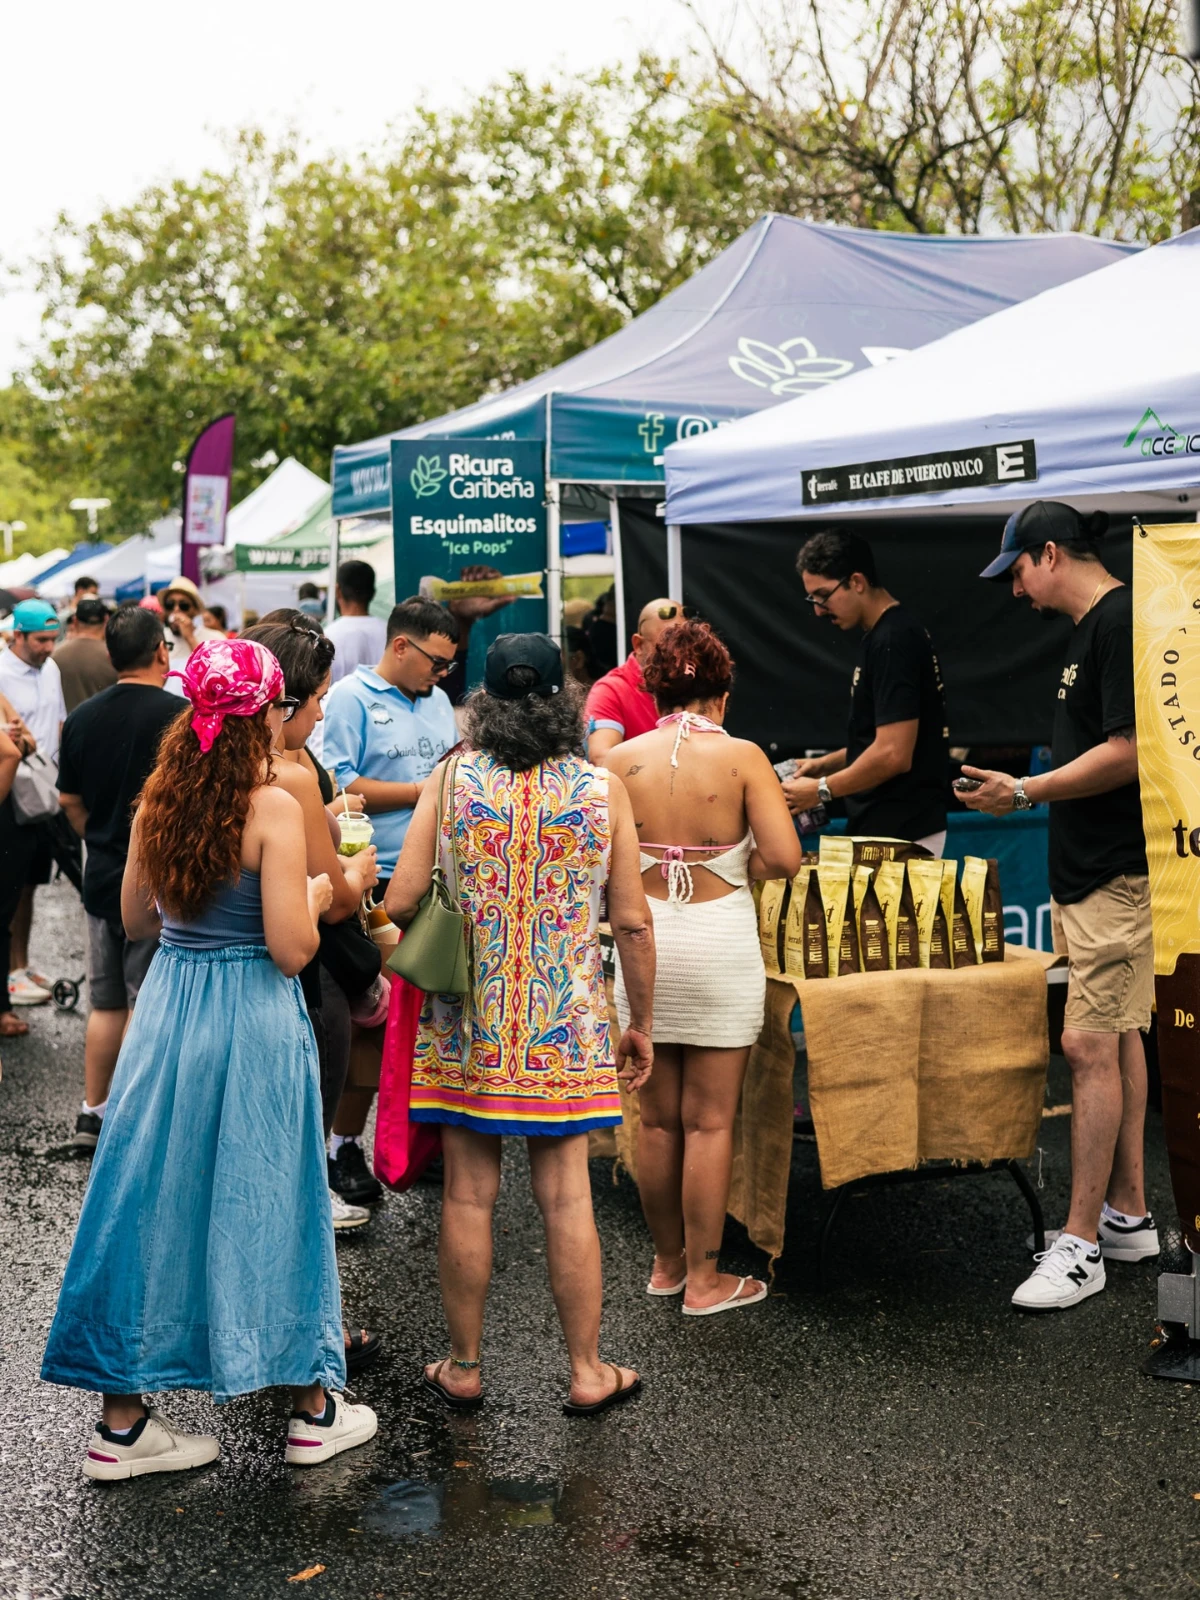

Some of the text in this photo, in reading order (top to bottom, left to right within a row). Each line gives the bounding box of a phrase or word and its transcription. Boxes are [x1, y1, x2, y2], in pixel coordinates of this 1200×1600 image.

[449, 454, 514, 476] Ricura
[848, 474, 863, 490] EL
[863, 470, 890, 489] CAFE
[891, 468, 905, 485] DE
[905, 462, 952, 484] PUERTO
[952, 457, 984, 478] RICO
[449, 476, 535, 499] Caribeña
[410, 513, 537, 538] Esquimalitos
[1174, 1008, 1194, 1028] De
